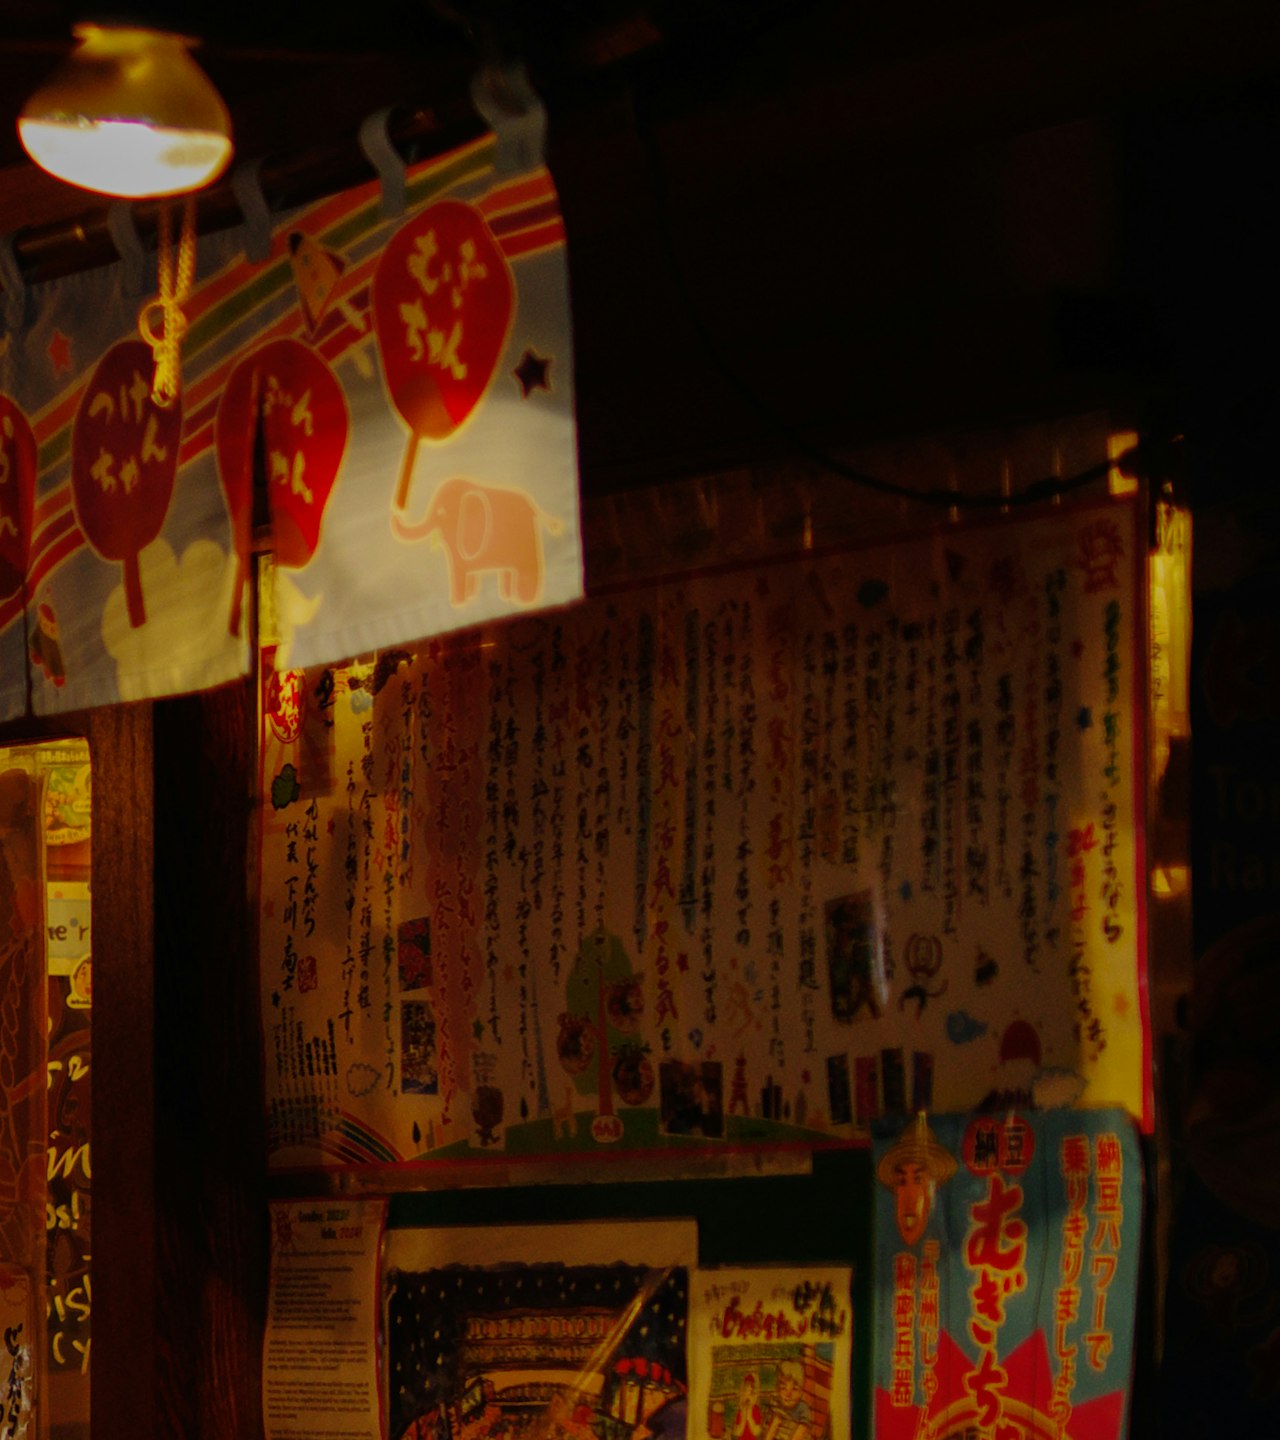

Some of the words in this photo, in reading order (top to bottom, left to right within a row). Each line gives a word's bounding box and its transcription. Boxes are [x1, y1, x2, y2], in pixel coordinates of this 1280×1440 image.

[399, 298, 468, 384] ちゃん
[973, 1121, 1029, 1172] 納豆
[1085, 1134, 1122, 1371] 納豆パワーで
